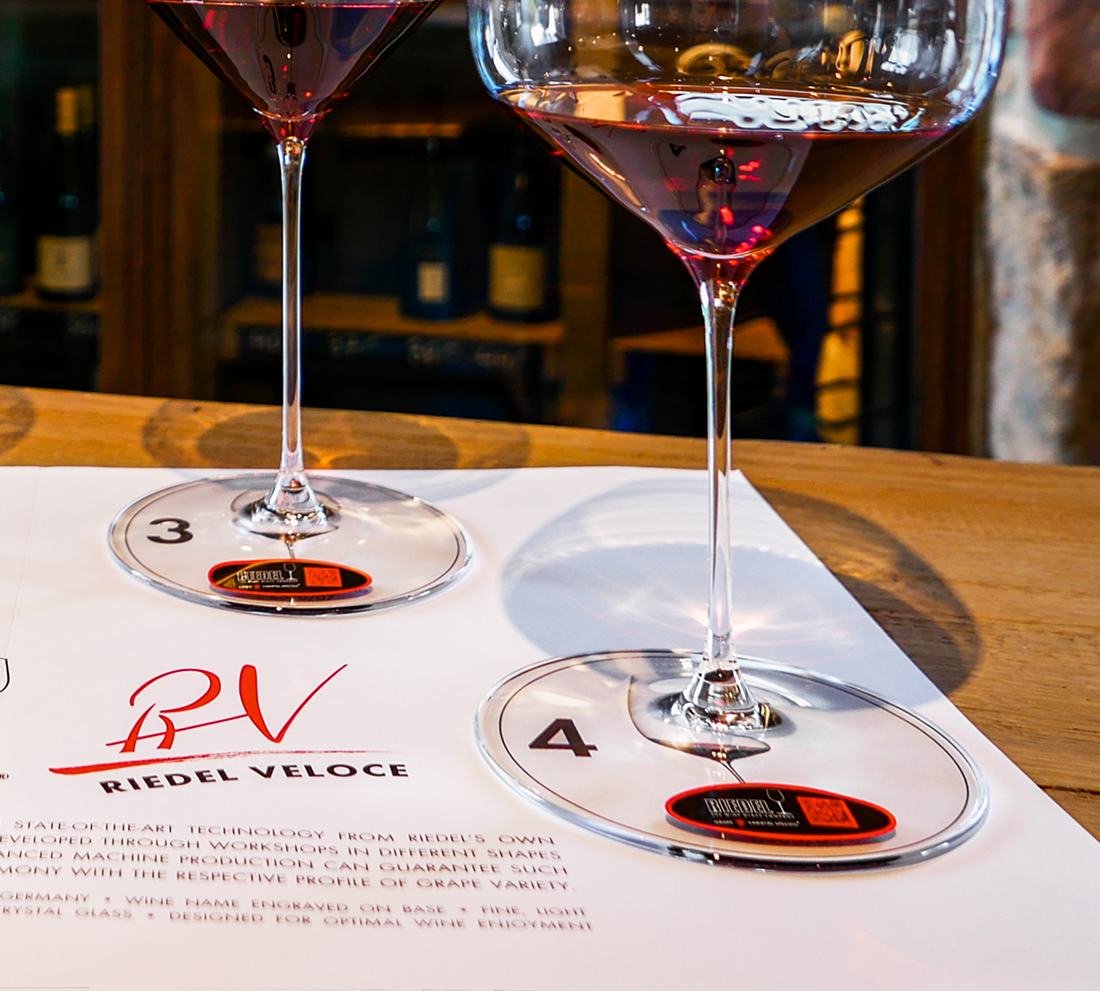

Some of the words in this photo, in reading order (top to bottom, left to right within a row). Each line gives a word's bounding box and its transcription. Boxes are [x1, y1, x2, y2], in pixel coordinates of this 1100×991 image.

[147, 518, 194, 544] 3
[528, 717, 598, 758] 4
[99, 769, 239, 794] RIEDEL
[249, 762, 409, 780] VELOCE
[188, 825, 325, 839] TECHNOLOGY
[338, 831, 395, 842] FROM
[408, 833, 486, 844] RIEDEL'S
[499, 835, 555, 845] OWN
[102, 837, 200, 849] THROUGH
[209, 840, 339, 855] WORKSHOPS
[348, 846, 370, 857] IN
[379, 847, 478, 859] DIFFERENT
[487, 848, 561, 860] SHAPES
[74, 851, 170, 864] MACHINE
[179, 855, 315, 870] PRODUCTION
[324, 860, 370, 872] CAN
[379, 862, 502, 874] GUARANTEE
[511, 864, 568, 875] SUCH
[71, 867, 123, 878] WITH
[131, 869, 167, 880] THE
[176, 871, 286, 884] RESPECTIVE
[296, 875, 371, 887] PROFILE
[380, 877, 407, 888] OF
[416, 878, 482, 890] GRAPE
[0, 890, 90, 903] GERMANY
[125, 895, 174, 906] WINE
[186, 897, 240, 908] NAME
[251, 899, 348, 912] ENGRAVED
[360, 903, 390, 913] ON
[402, 904, 446, 914] BASE
[537, 907, 586, 917] LIGHT
[76, 907, 133, 919] GLASS
[170, 911, 264, 923] DESIGNED
[276, 914, 311, 924] FOR
[323, 915, 402, 928] OPTIMAL
[414, 917, 466, 928] WINE
[478, 919, 593, 931] ENJOYMENT
